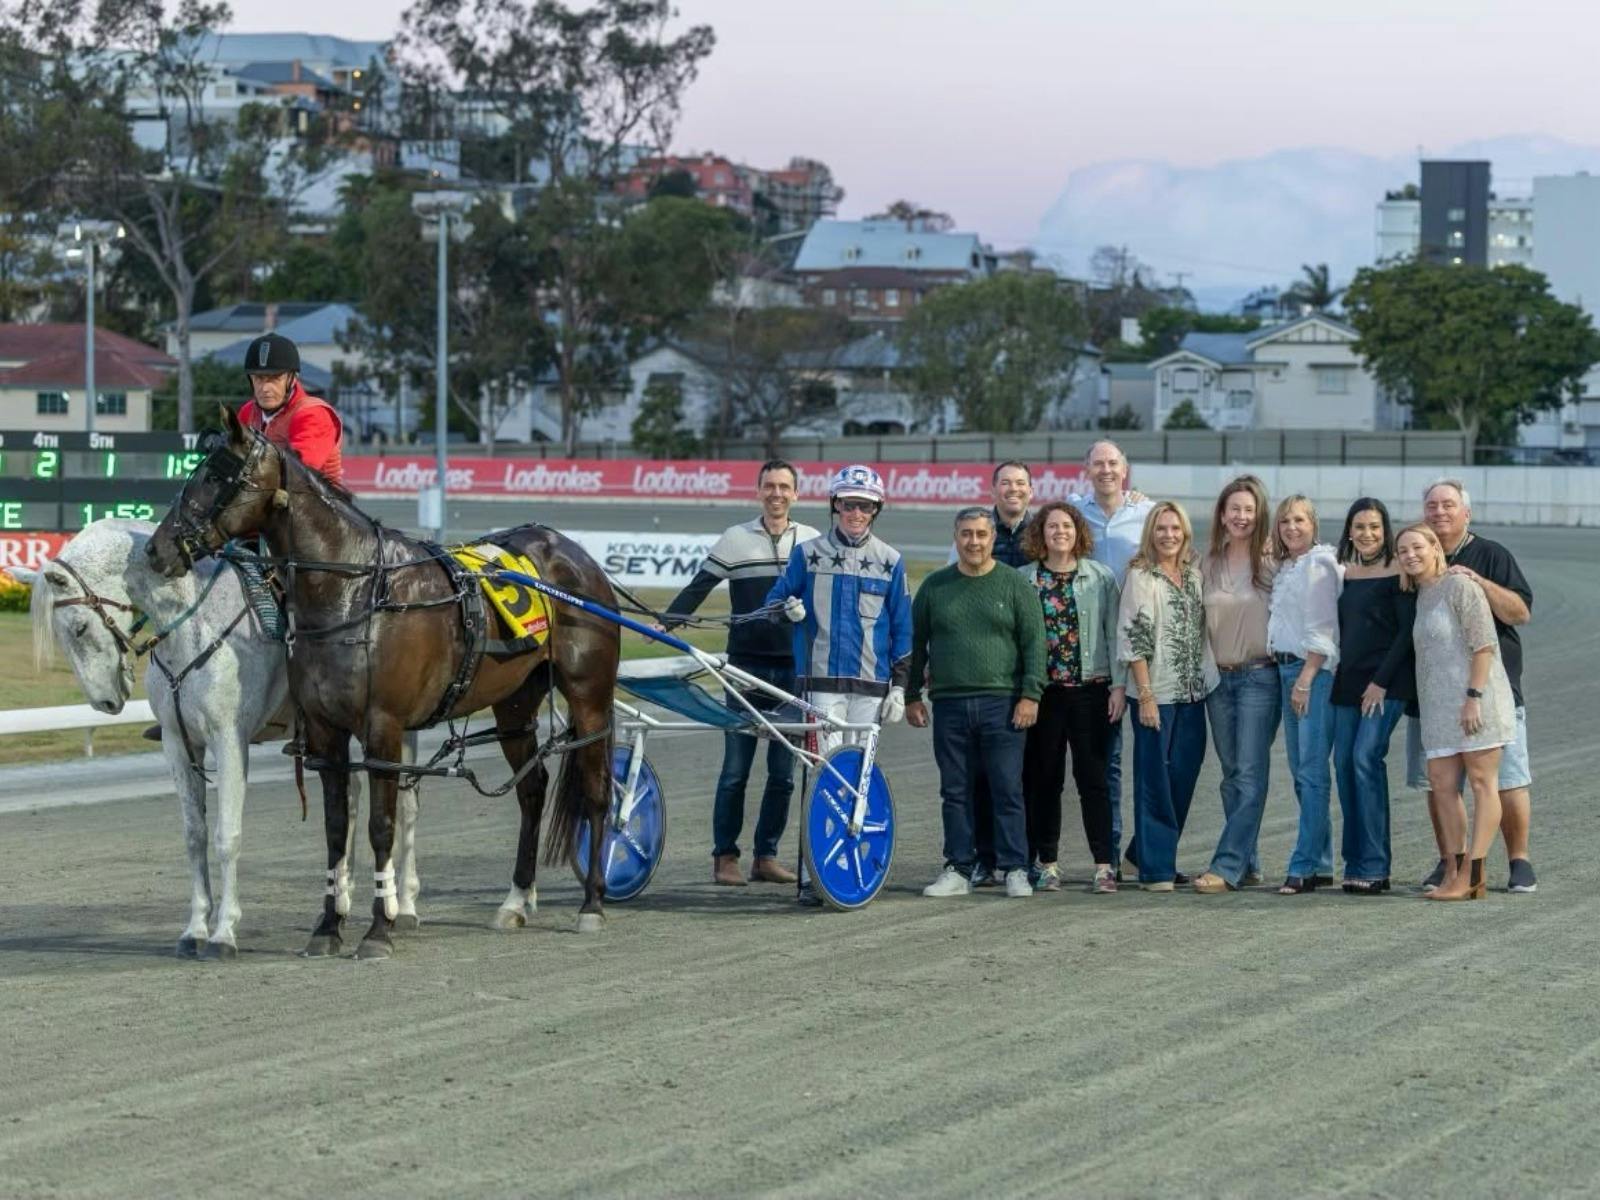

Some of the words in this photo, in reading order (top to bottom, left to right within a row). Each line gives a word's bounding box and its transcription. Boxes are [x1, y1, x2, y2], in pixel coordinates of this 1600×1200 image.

[33, 432, 59, 448] 4TH
[90, 433, 115, 448] 5TH
[182, 433, 200, 450] TI
[37, 451, 57, 478] 2
[106, 453, 115, 478] 1
[375, 462, 474, 490] Ladbrokes
[503, 464, 604, 492] Ladbrokes
[632, 465, 732, 495] Ladbrokes
[887, 468, 983, 498] Ladbrokes
[607, 542, 659, 554] KEVIN
[661, 543, 675, 555] &
[605, 555, 703, 575] SEYM
